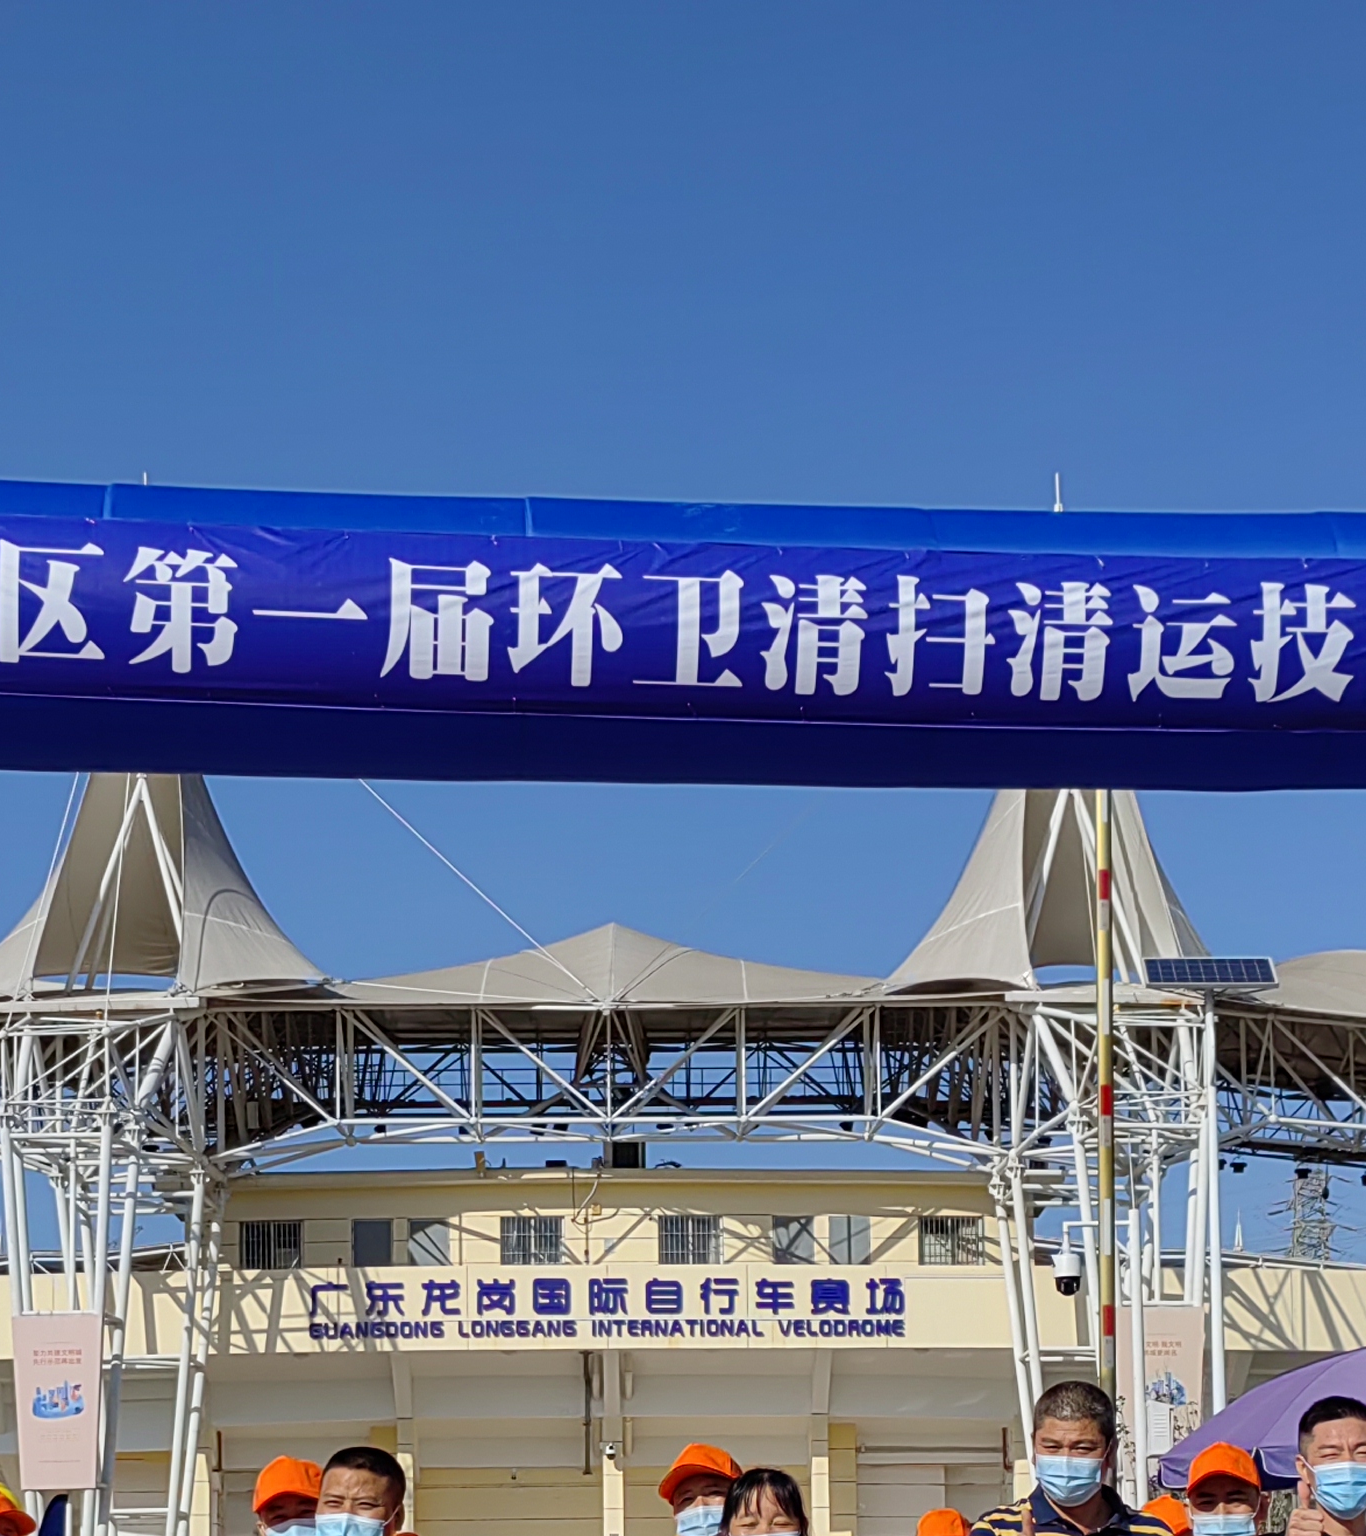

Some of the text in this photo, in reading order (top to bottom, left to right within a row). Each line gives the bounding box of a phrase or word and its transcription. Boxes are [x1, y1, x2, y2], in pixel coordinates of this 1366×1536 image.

[309, 1277, 906, 1317] 广东龙岗国际自行车赛场
[309, 1319, 906, 1340] GUANGDONG LONGGANG INTERNATIONAL VELODROME
